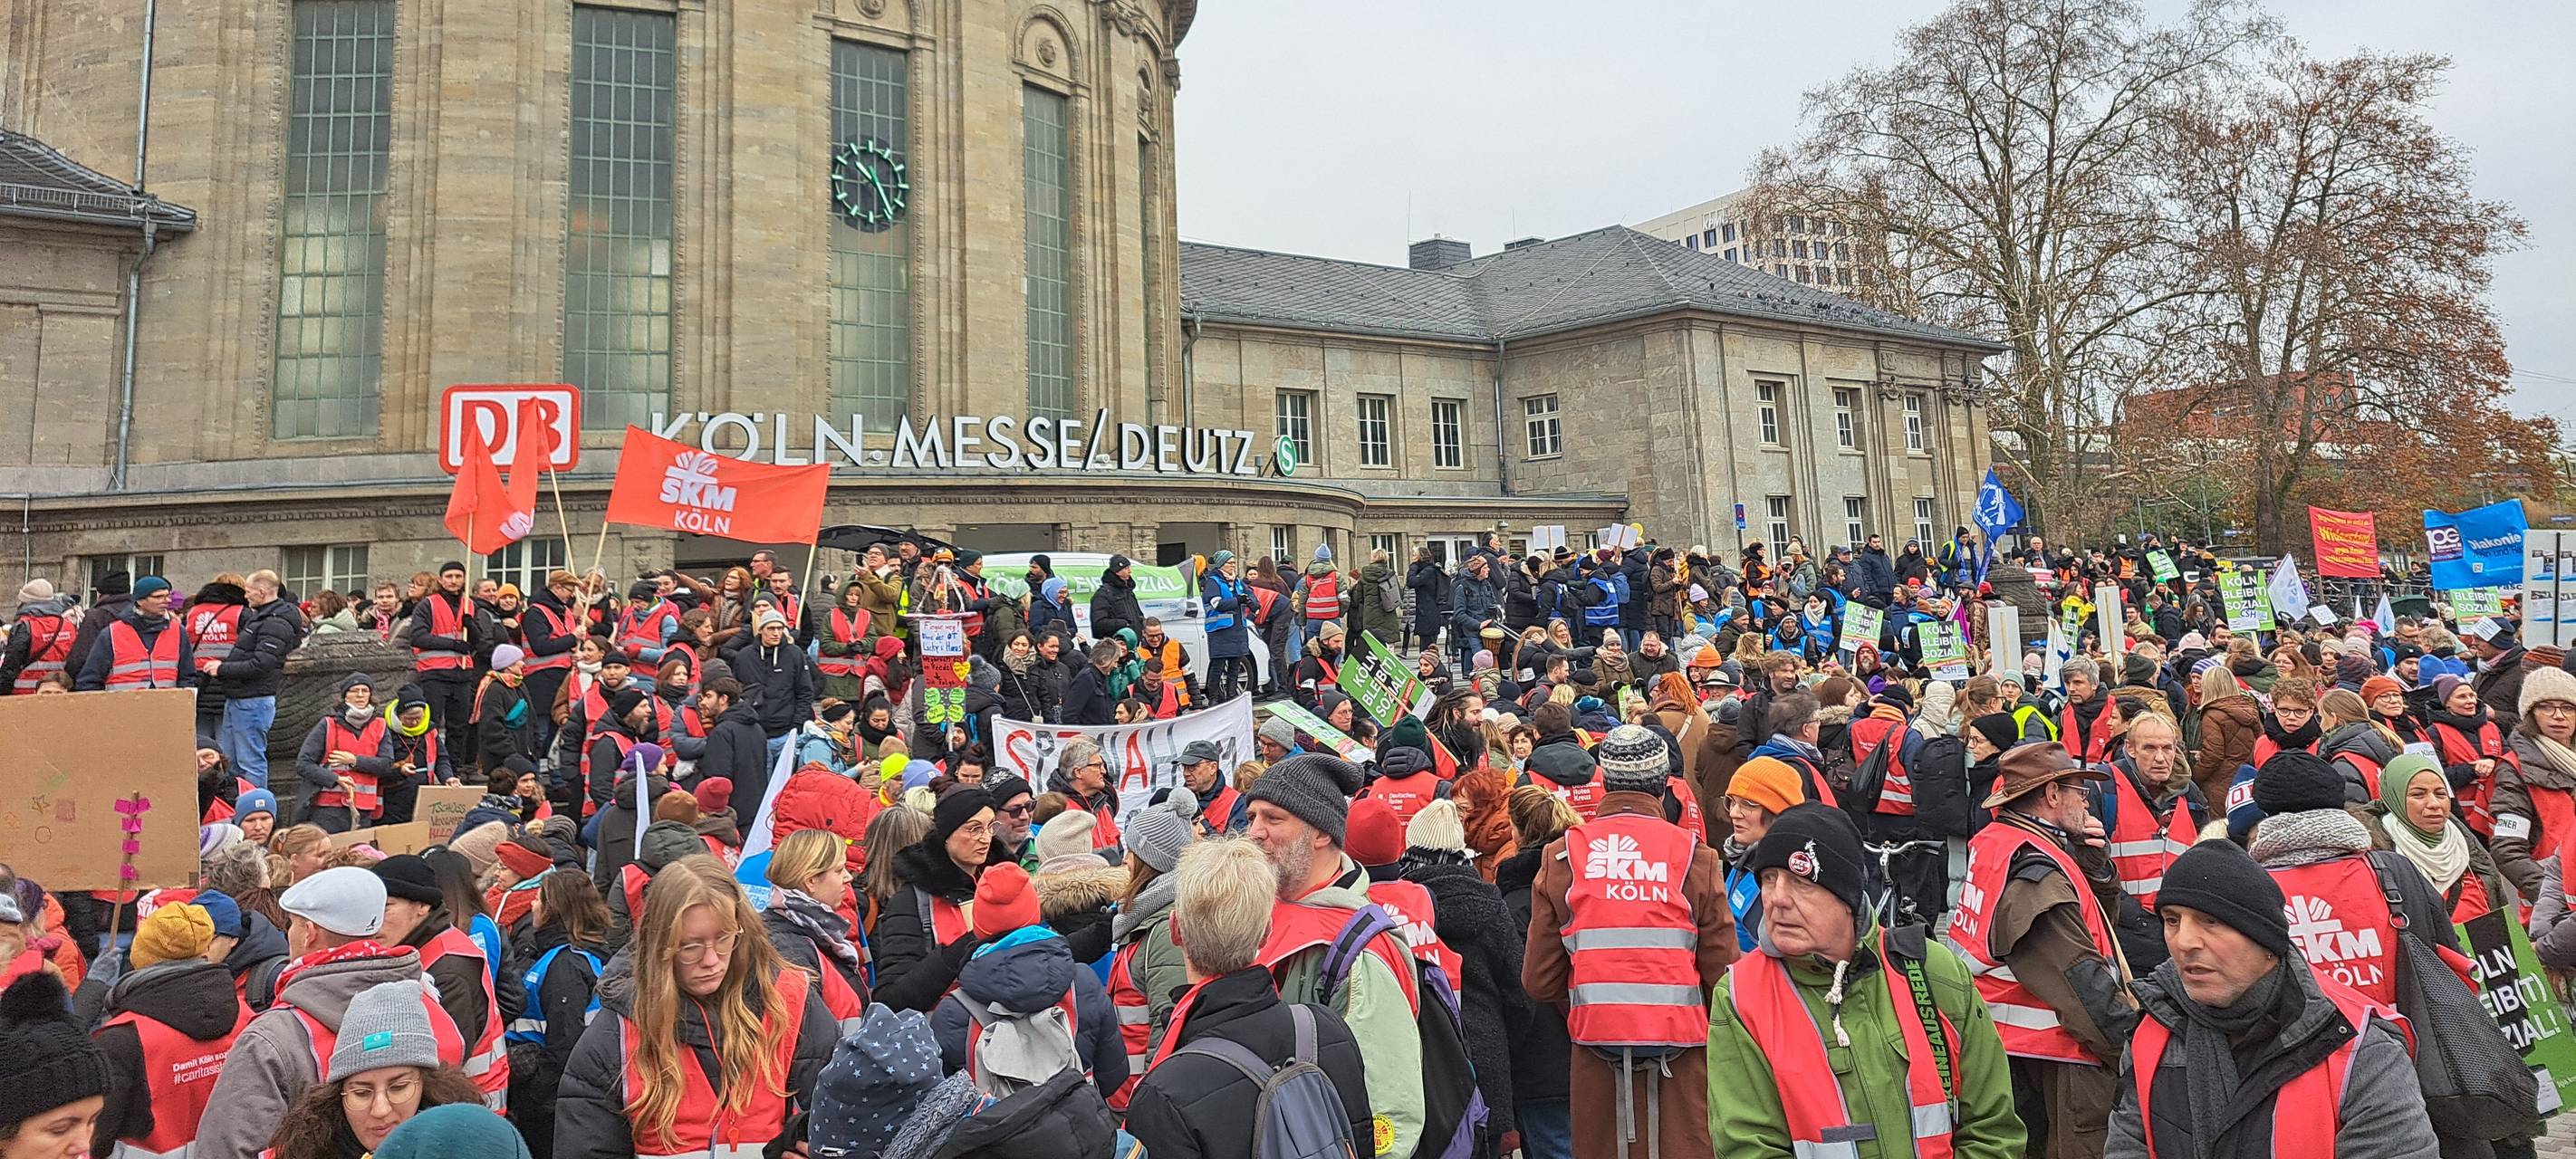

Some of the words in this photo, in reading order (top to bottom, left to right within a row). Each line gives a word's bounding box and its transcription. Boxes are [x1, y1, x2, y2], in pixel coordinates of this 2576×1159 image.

[460, 399, 562, 457] DB
[890, 408, 1255, 475] MESSE/DEUTZ
[659, 479, 738, 512] SKM
[673, 507, 732, 535] KÖLN
[2222, 586, 2267, 599] BLEIB(T)
[2226, 575, 2258, 588] KÖLN
[1850, 604, 1877, 619] KÖLN
[2225, 599, 2269, 611] SOZIAL!
[2458, 602, 2500, 613] SOZIAL!
[1842, 622, 1879, 638] SOZIAL!
[1844, 614, 1880, 631] BLEIB(T)
[1925, 624, 1953, 635] KÖLN
[1921, 635, 1962, 647] BLEIB(T)
[1922, 647, 1964, 659] SOZIAL!
[1352, 649, 1379, 688] KÖLN
[1375, 669, 1408, 718] SOZIAL!
[1584, 859, 1668, 883] SKM
[1606, 881, 1668, 903] KÖLN
[1954, 903, 1979, 938] ÖLN
[2330, 962, 2384, 987] ÖLN
[2467, 945, 2517, 983] ÖLN
[2479, 972, 2547, 1018] EIB(T)
[2501, 1009, 2562, 1050] ZIAL!
[173, 1058, 197, 1073] Damit
